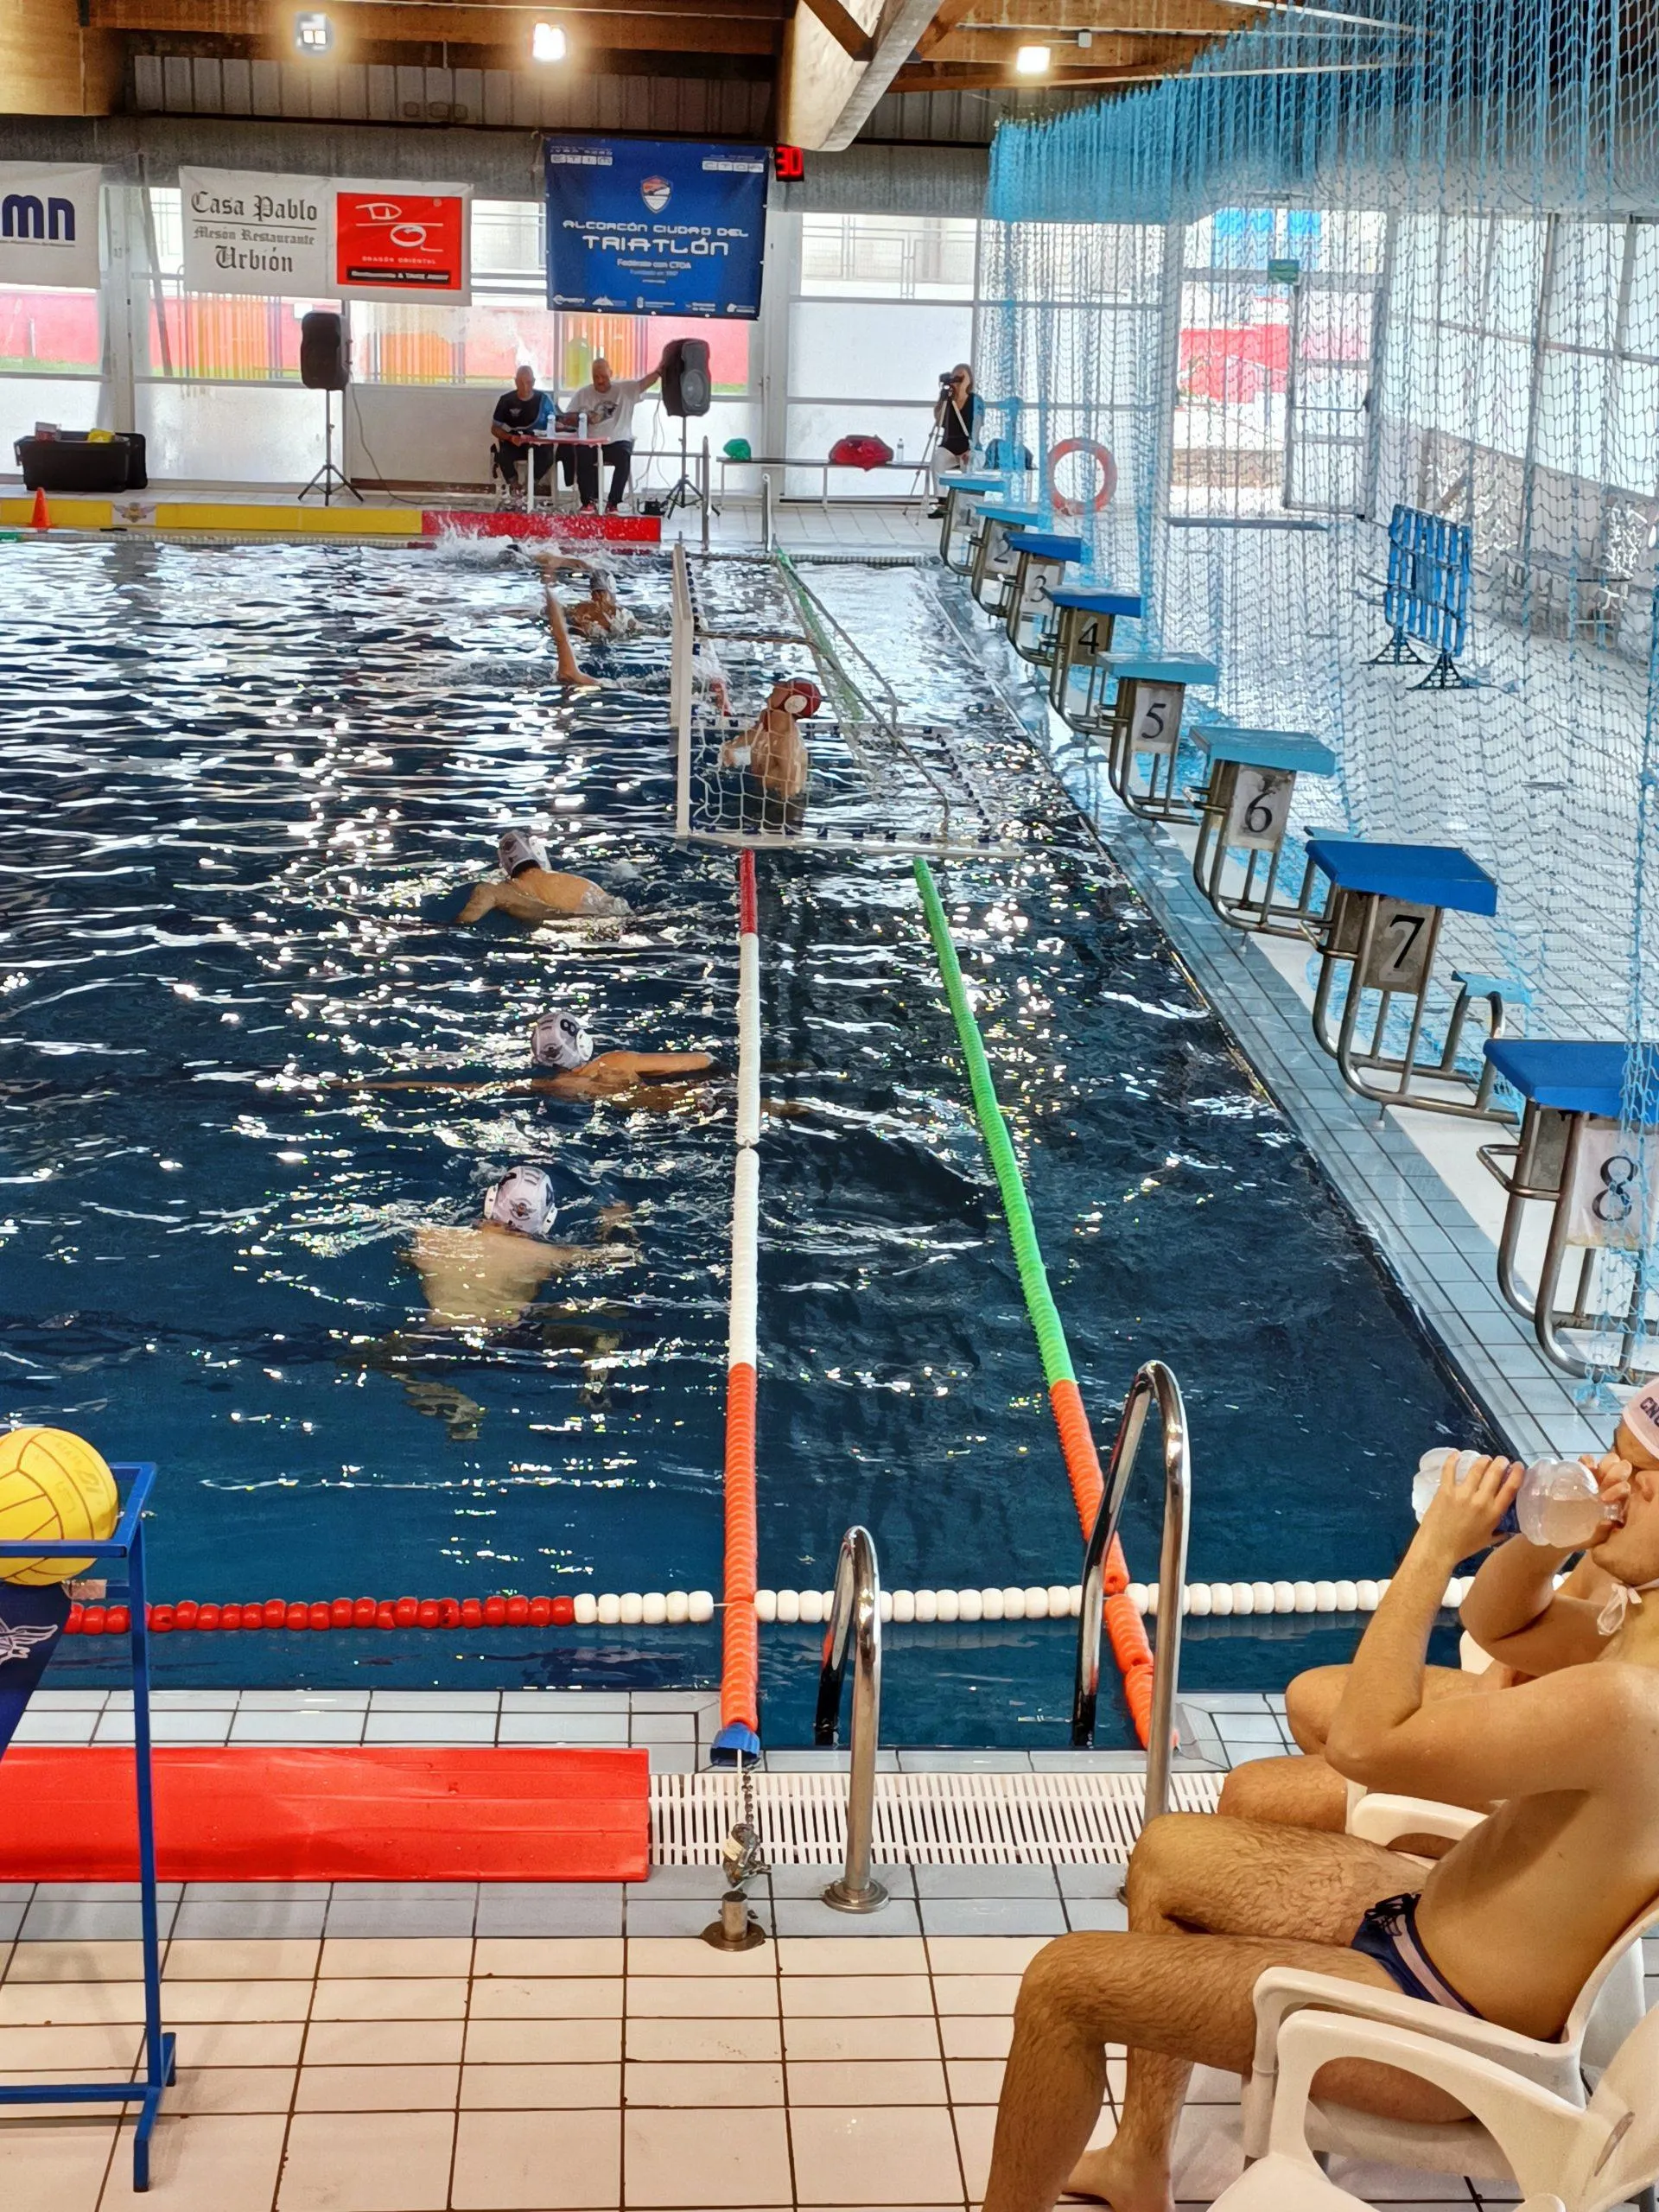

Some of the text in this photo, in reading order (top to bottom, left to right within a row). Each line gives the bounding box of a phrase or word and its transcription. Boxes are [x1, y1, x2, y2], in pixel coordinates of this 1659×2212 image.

[191, 191, 318, 222] Casa Pablo
[193, 226, 315, 245] Mesón Restaurante
[582, 235, 729, 256] TRIATLÓN
[716, 227, 749, 237] DEL
[215, 245, 293, 272] Urbión
[1077, 622, 1100, 655] 4
[1141, 702, 1167, 739] 5
[1244, 792, 1274, 833] 6
[1389, 914, 1425, 969] 7
[1592, 1155, 1637, 1222] 8
